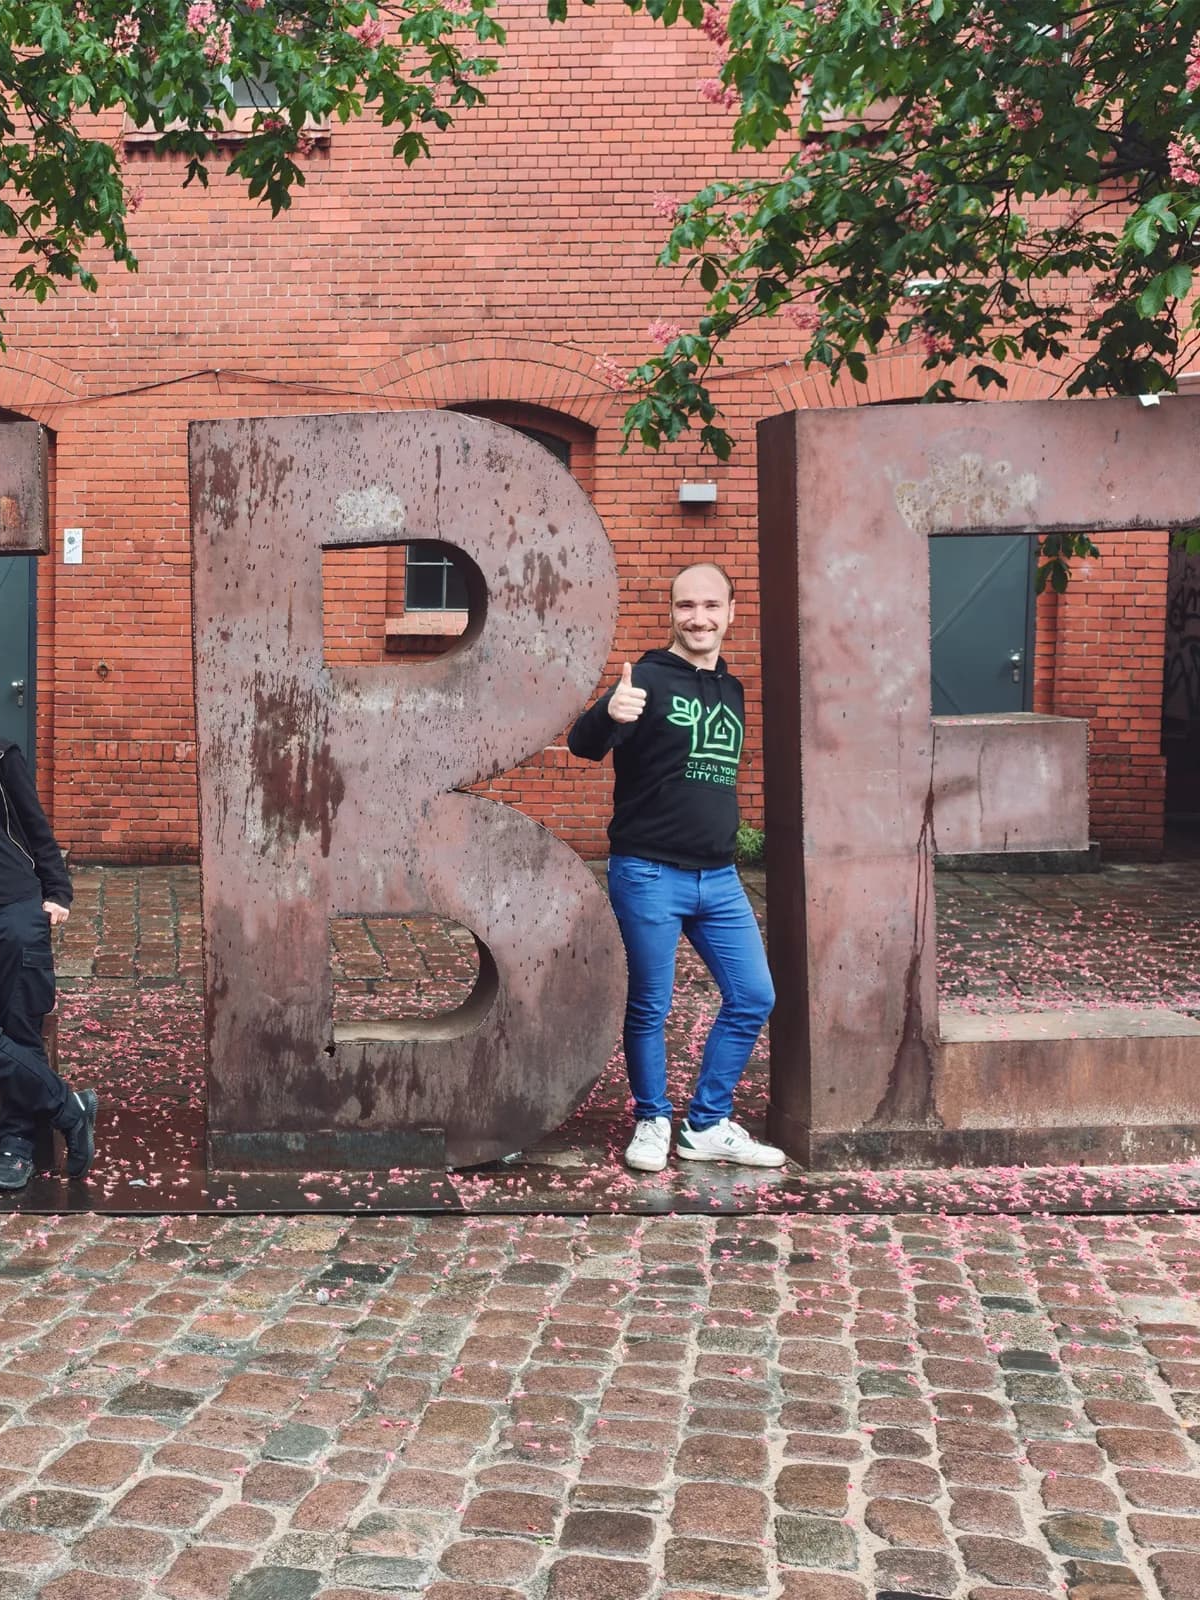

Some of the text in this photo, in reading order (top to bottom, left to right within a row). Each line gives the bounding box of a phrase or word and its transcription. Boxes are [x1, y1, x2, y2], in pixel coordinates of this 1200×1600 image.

[687, 761, 736, 776] CLEAN YOU
[685, 770, 736, 786] CITY GREE
